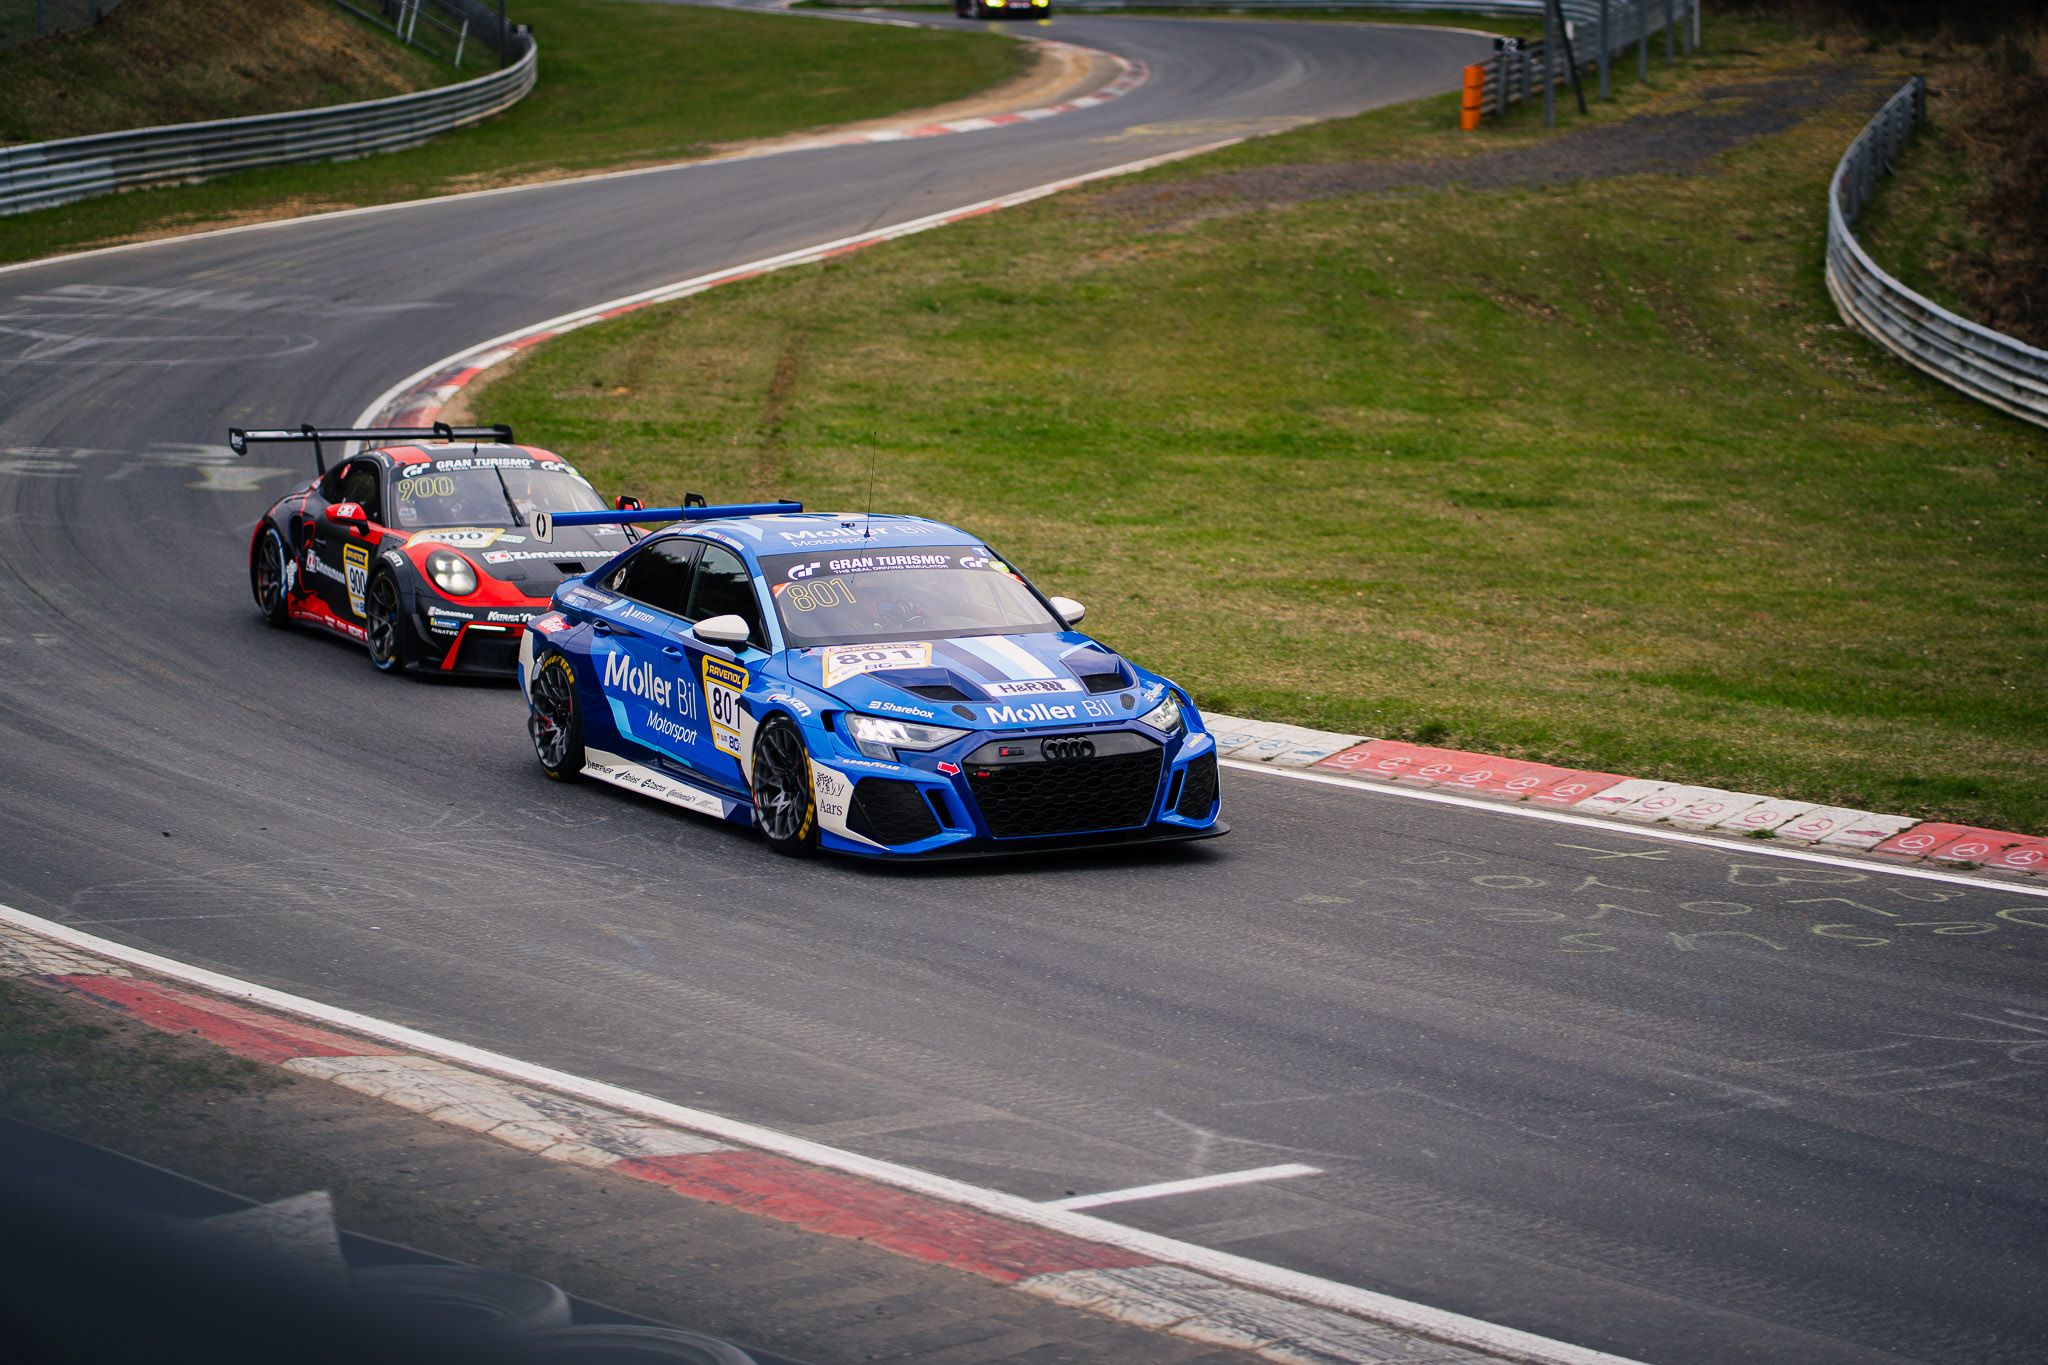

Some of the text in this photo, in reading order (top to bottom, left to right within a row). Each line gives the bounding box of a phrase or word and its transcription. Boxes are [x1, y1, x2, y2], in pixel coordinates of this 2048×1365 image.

[436, 459, 471, 470] GRAN
[474, 458, 530, 468] TURISMO
[398, 476, 454, 501] 900
[829, 555, 946, 570] GRAN TURISMO
[787, 577, 856, 611] 801
[836, 650, 912, 665] 801
[708, 664, 742, 685] RAVENOL
[998, 682, 1041, 693] H&R
[677, 678, 697, 720] Bil
[1081, 699, 1115, 717] Bil
[713, 687, 741, 730] 801
[882, 702, 935, 719] Sharebox
[646, 709, 698, 746] Motorsport
[820, 798, 843, 816] Aars
